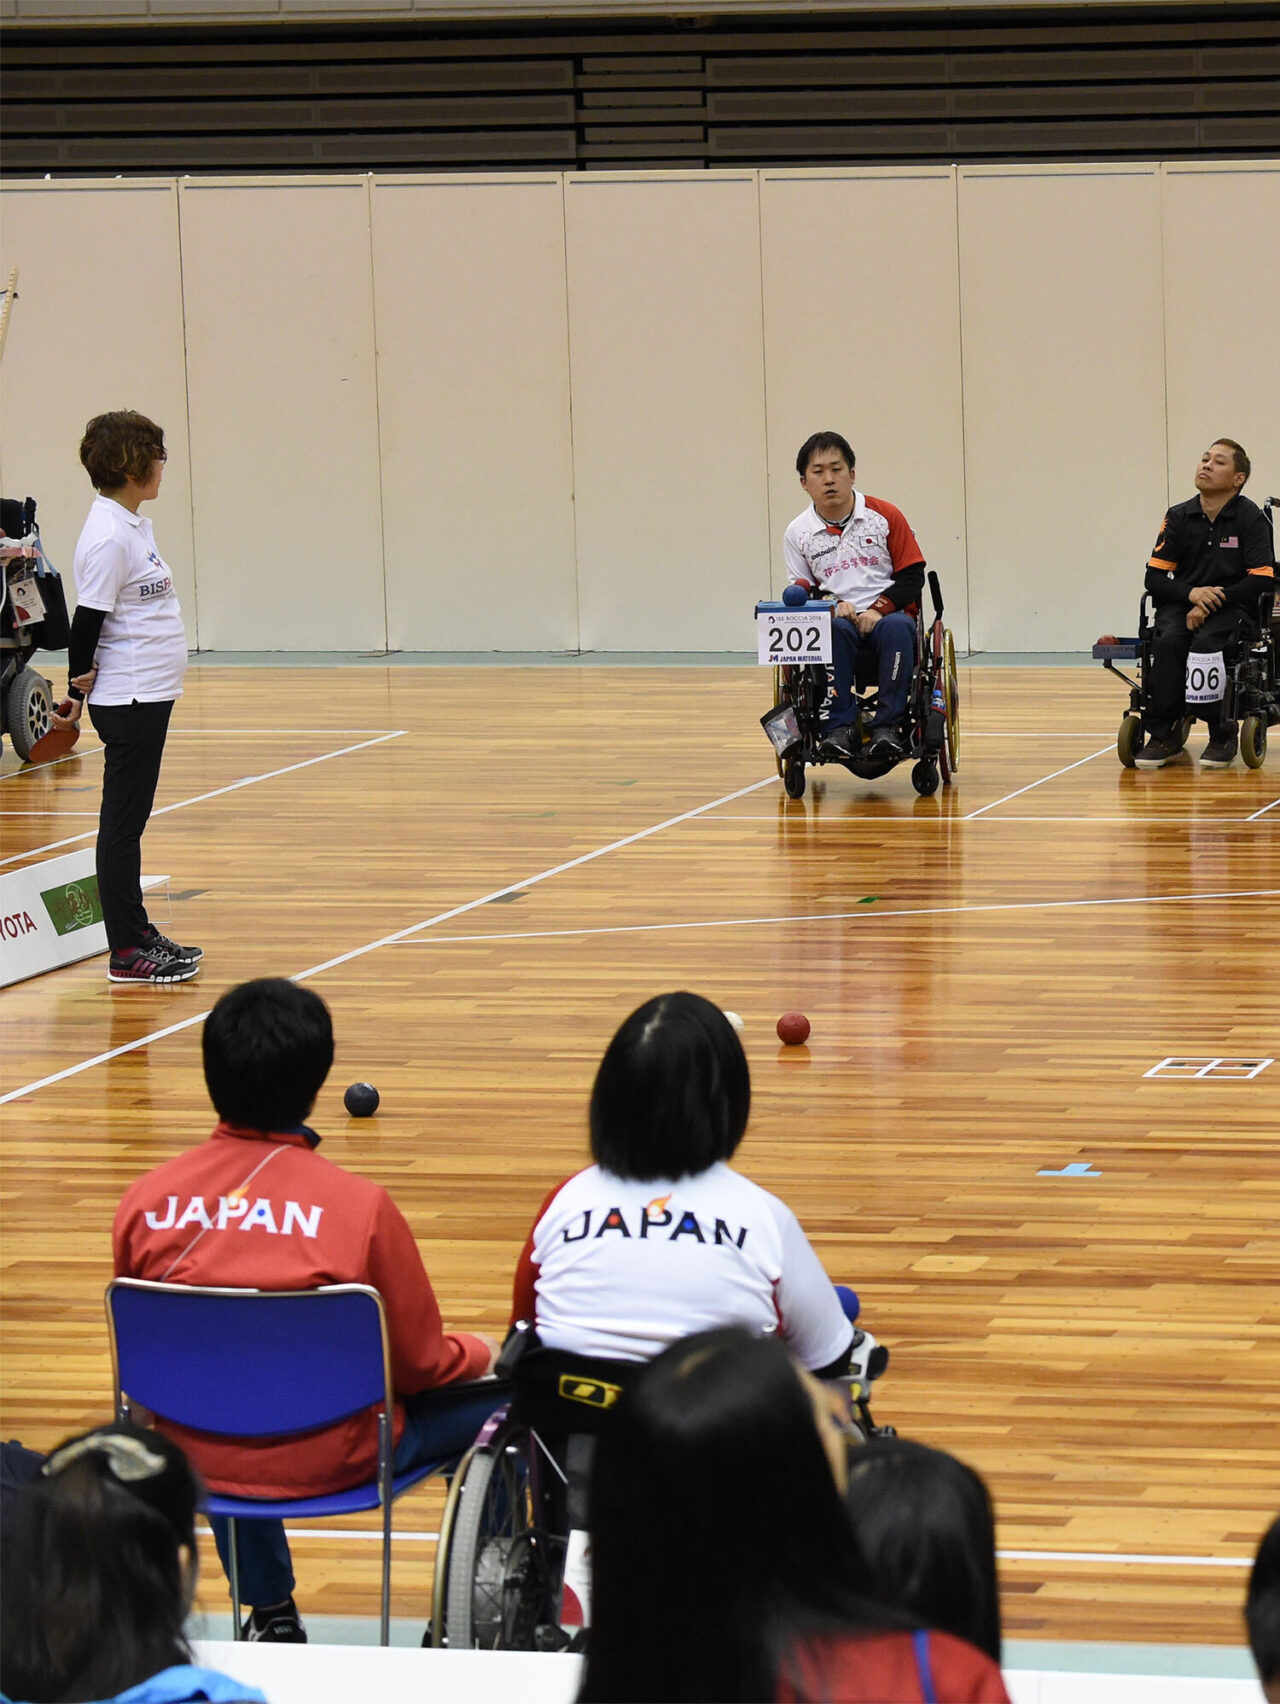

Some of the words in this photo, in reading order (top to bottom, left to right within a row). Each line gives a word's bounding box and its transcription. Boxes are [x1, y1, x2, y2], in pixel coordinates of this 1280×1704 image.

[768, 627, 821, 652] 202
[144, 1195, 324, 1238] JAPAN
[563, 1206, 748, 1249] JAPAN
